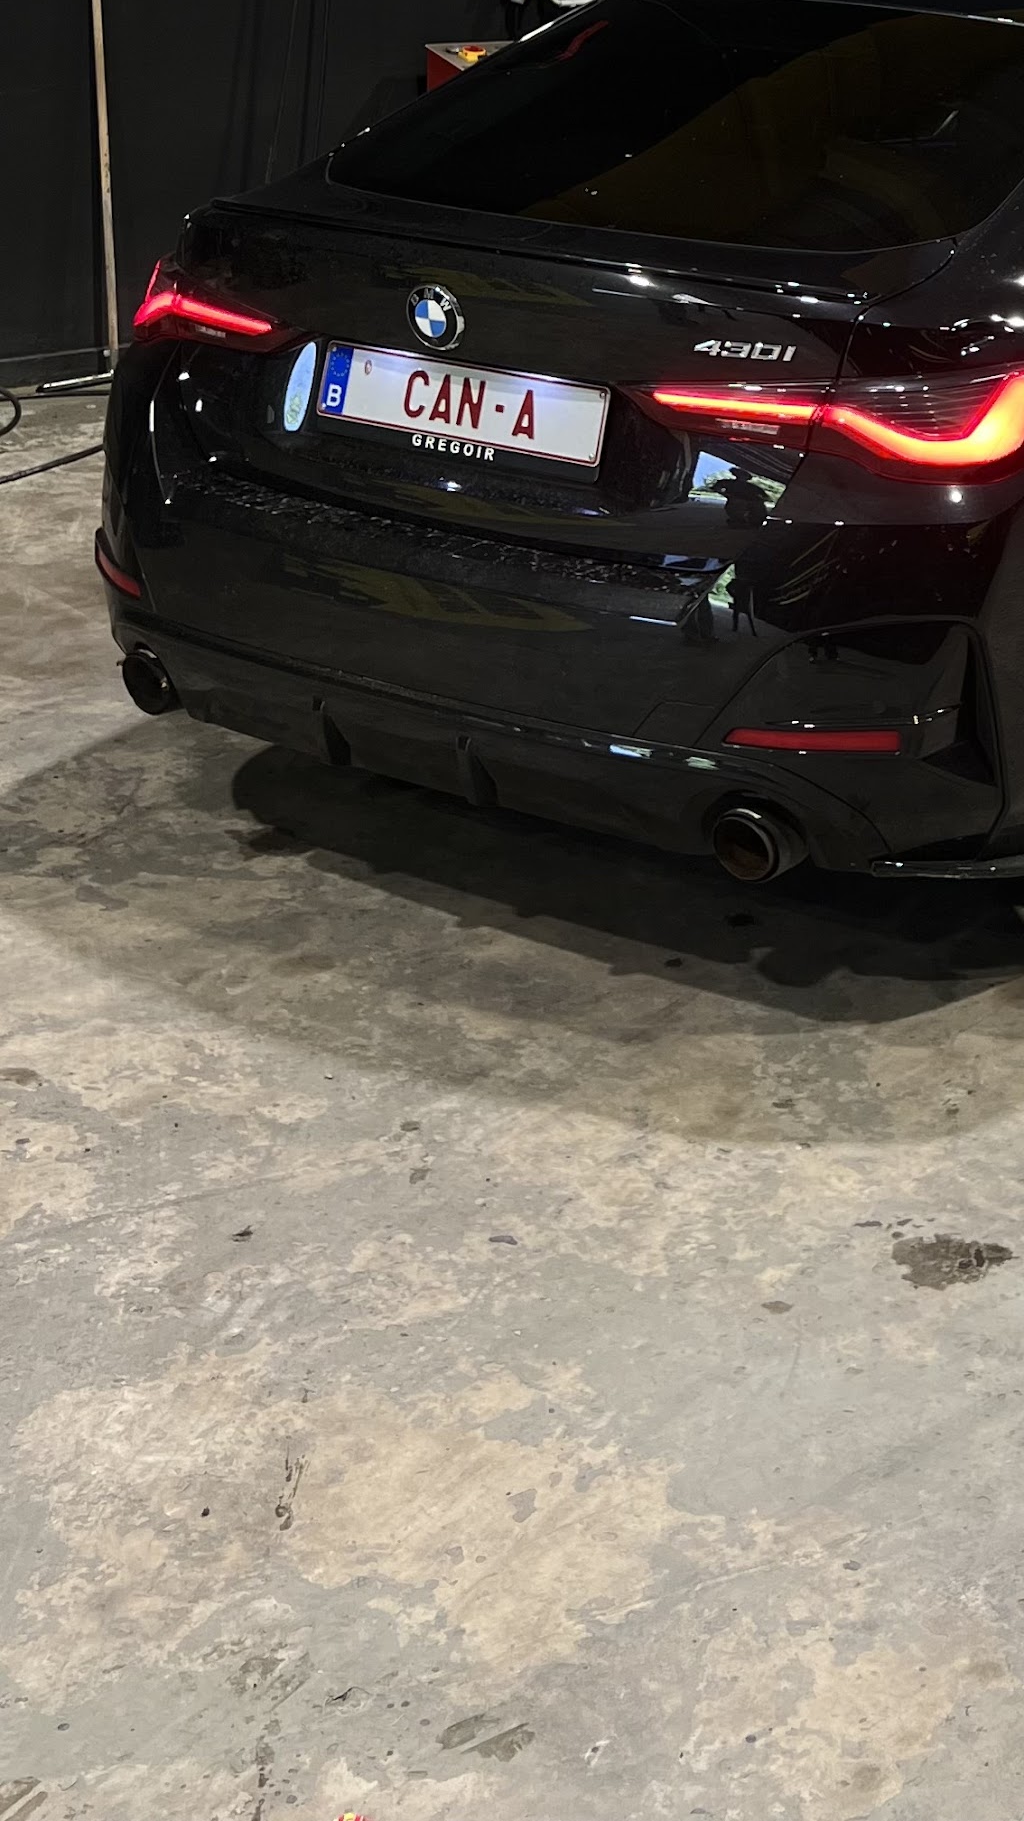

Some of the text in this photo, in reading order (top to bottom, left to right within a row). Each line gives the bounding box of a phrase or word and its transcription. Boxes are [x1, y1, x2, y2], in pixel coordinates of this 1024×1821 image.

[410, 286, 452, 312] BMW
[326, 383, 342, 407] B
[403, 369, 535, 440] CAN-A
[411, 433, 496, 462] GREGOIR
